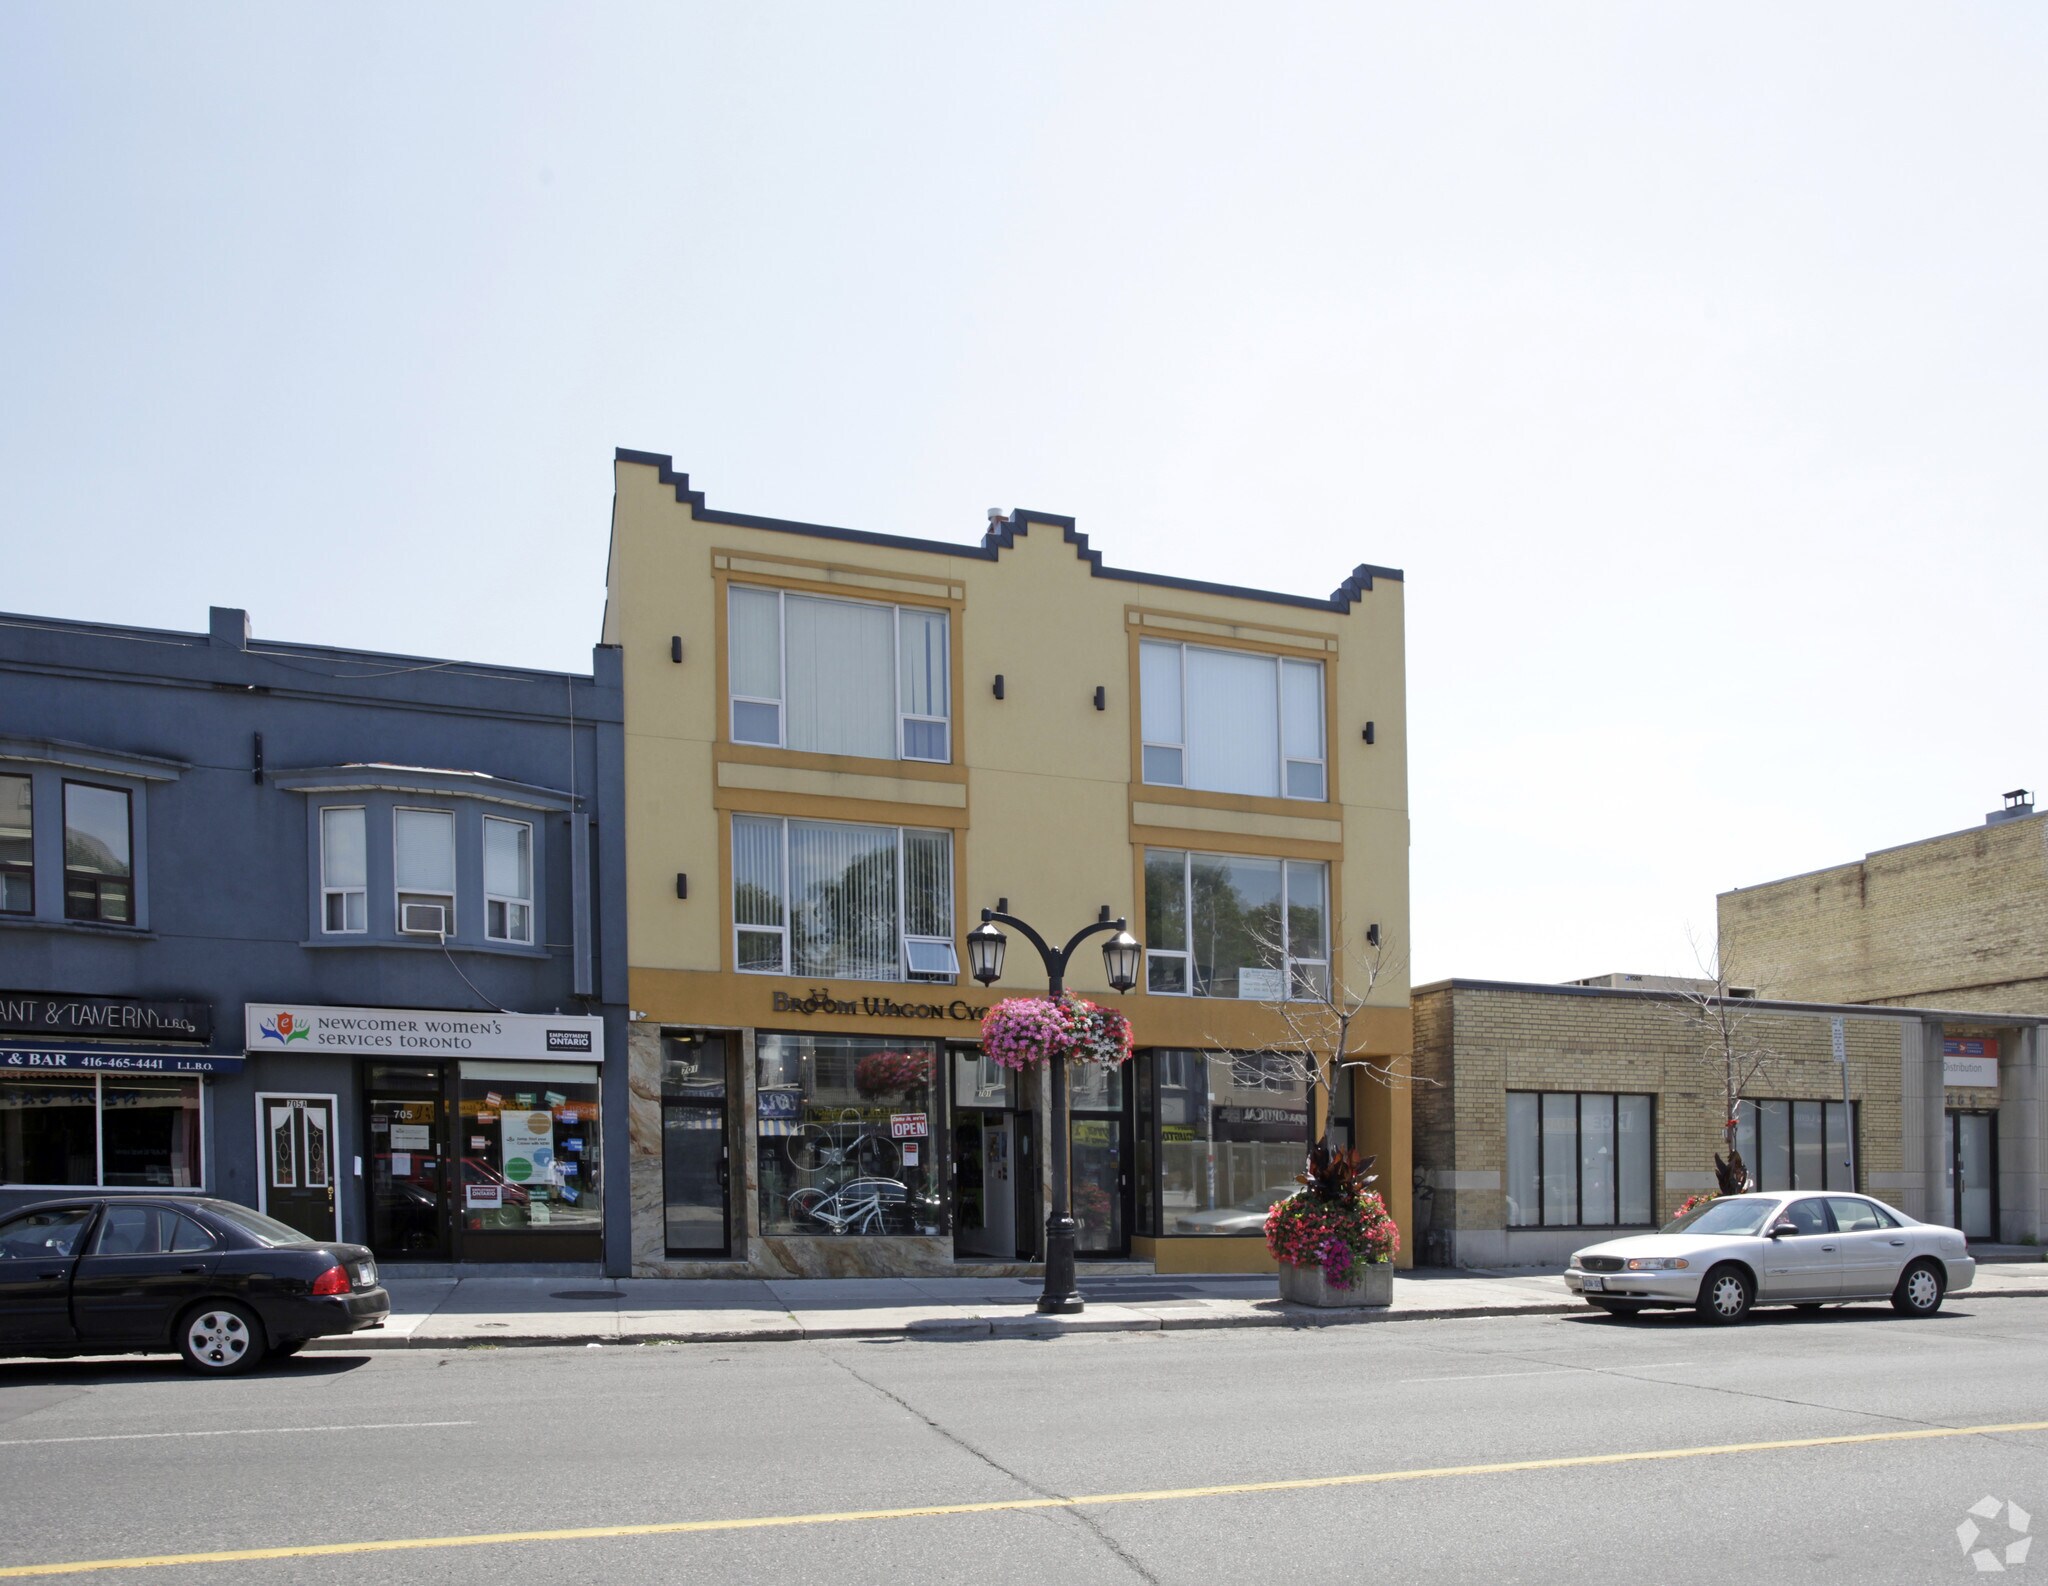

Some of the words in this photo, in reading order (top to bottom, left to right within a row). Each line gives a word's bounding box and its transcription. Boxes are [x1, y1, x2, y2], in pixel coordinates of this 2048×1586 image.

[67, 1003, 151, 1028] TAVERN
[549, 1037, 589, 1046] ONTARIO
[8, 1053, 23, 1065] &
[29, 1053, 67, 1066] BAR
[81, 1056, 163, 1069] 416-465-4441
[1943, 1061, 1983, 1073] Distribution
[682, 1065, 697, 1074] 701
[393, 1110, 413, 1119] 705
[894, 1122, 926, 1136] OPEN
